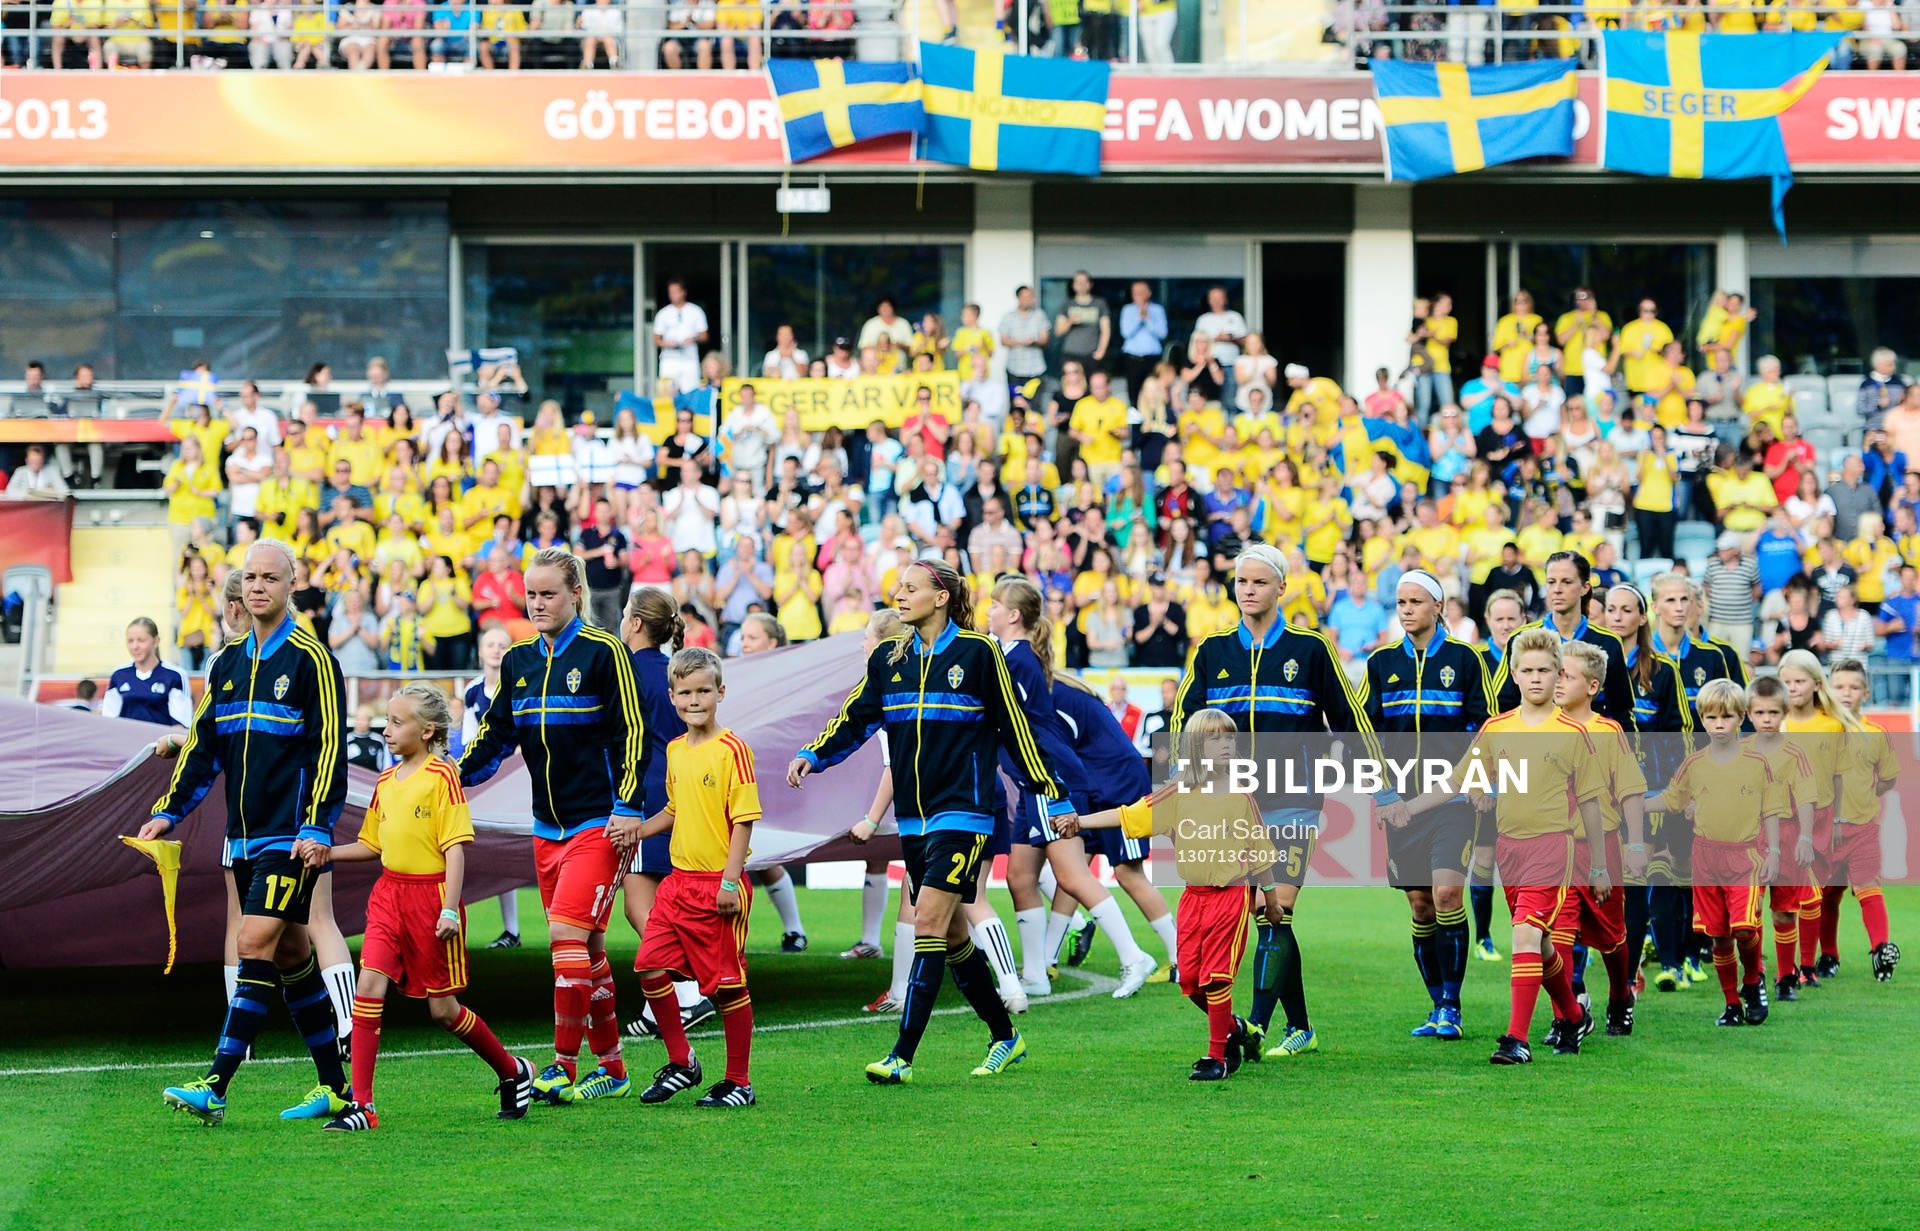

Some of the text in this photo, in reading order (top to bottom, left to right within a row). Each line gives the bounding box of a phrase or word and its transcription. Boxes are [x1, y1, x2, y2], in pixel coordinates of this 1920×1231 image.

[544, 89, 779, 140] GÖTEBOR
[1643, 89, 1736, 116] SEGER
[946, 852, 966, 885] 2
[1285, 845, 1303, 878] 5
[264, 874, 297, 911] 17
